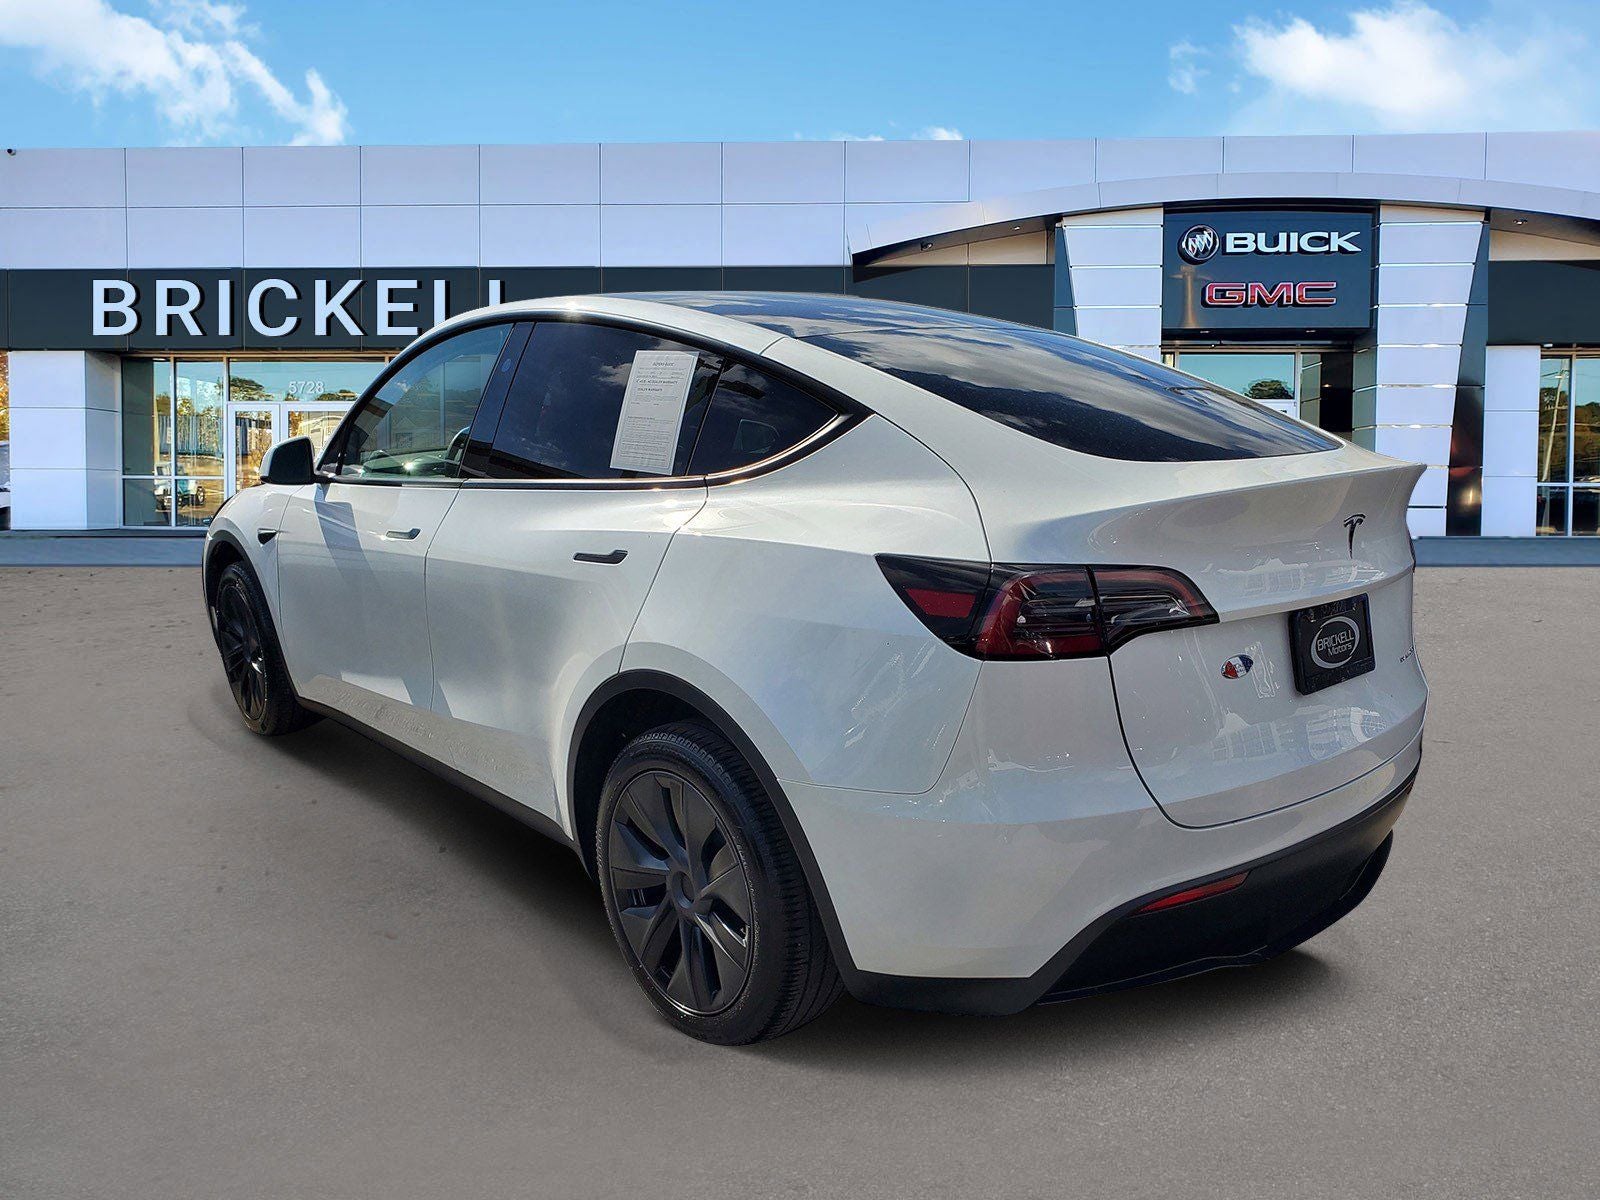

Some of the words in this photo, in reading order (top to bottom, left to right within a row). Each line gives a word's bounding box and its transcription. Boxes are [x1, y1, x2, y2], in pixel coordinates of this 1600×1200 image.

[1225, 231, 1362, 253] BUICK
[1205, 282, 1337, 305] GMC
[288, 380, 325, 395] 5728
[1317, 630, 1354, 651] BRICKELL
[1327, 642, 1353, 657] Motors
